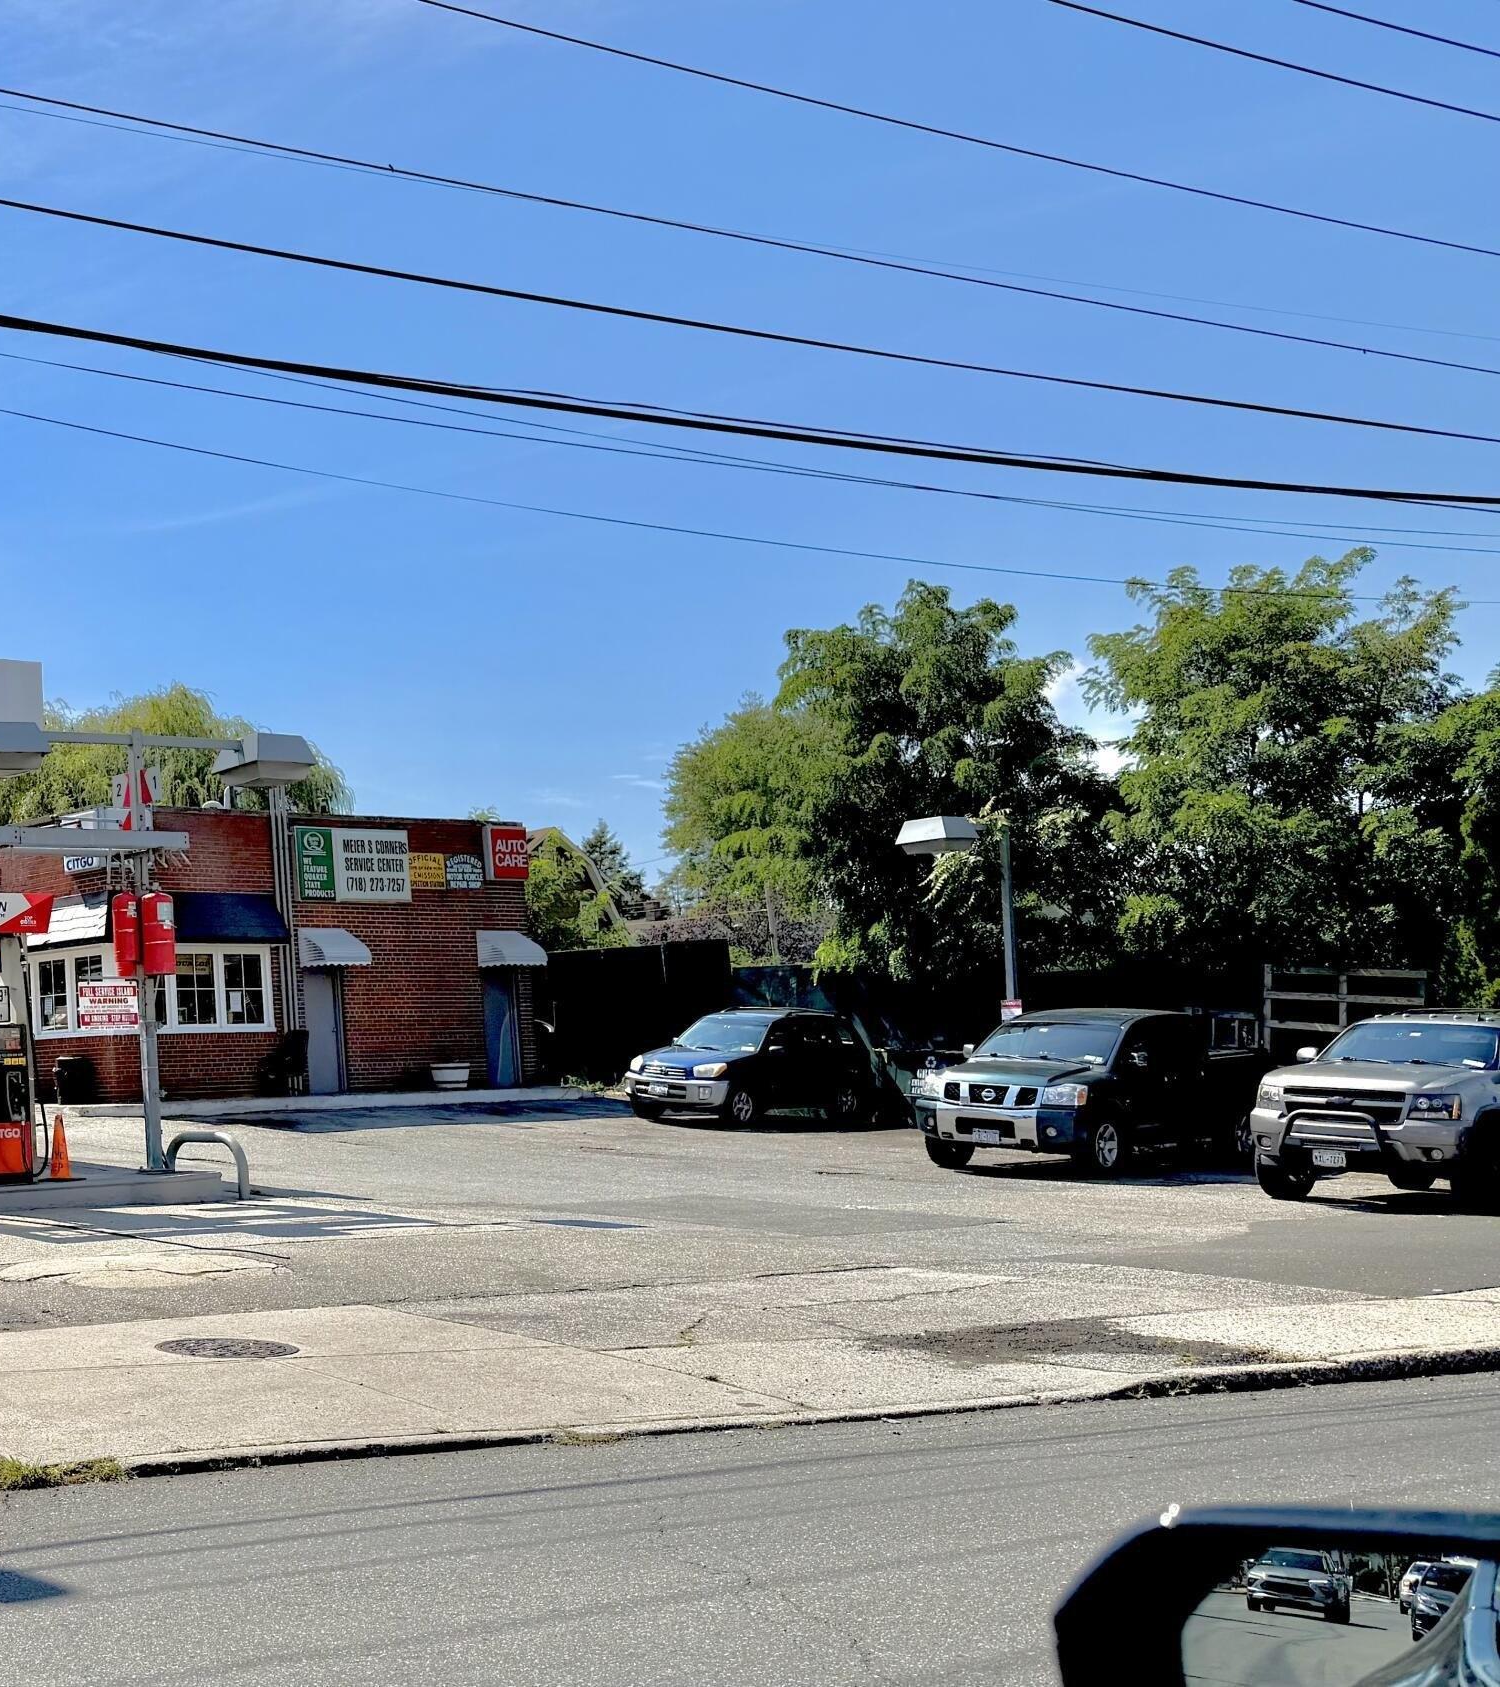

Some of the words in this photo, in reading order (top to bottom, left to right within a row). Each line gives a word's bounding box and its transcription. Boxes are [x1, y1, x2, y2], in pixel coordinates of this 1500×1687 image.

[116, 783, 122, 797] 2
[342, 839, 366, 853] MEIER
[375, 840, 407, 854] CORNERS
[495, 839, 527, 853] AUTO
[66, 855, 94, 871] CITGO
[345, 858, 374, 872] SERVICE
[377, 858, 404, 872] CENTER
[446, 854, 482, 868] REGISTERED
[495, 854, 528, 868] CARE
[304, 865, 328, 873] FEATURE
[304, 873, 328, 881] QUAKER
[304, 881, 321, 889] STATE
[346, 877, 367, 892] (718)
[304, 889, 335, 898] PRODUCTS
